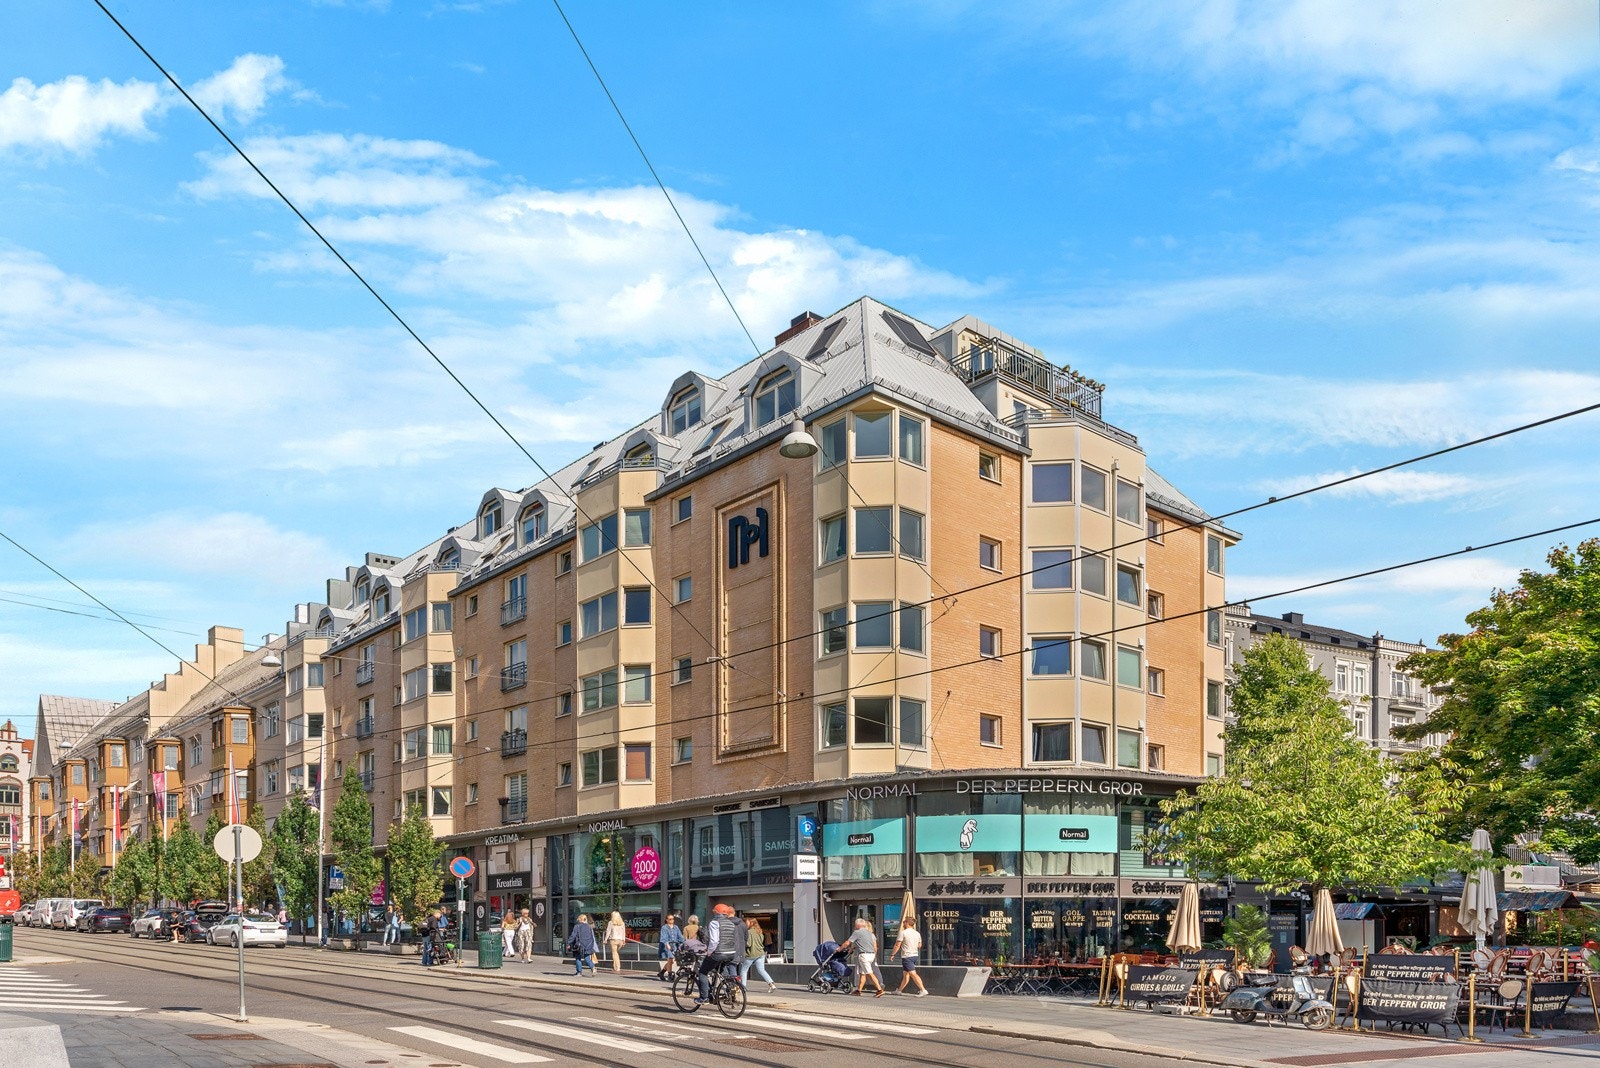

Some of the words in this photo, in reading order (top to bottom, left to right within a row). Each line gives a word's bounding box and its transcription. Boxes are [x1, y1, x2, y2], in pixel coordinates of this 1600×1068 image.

[846, 783, 922, 800] NORMAL
[956, 780, 996, 794] DER
[1005, 779, 1097, 793] PEPPERN
[1100, 781, 1143, 795] GROR
[588, 819, 626, 832] NORMAL
[485, 833, 519, 845] KREATIMA
[849, 834, 872, 844] Normal
[1062, 829, 1087, 838] Normal
[702, 845, 737, 856] SAMSØE
[764, 839, 796, 851] SAMSØ
[634, 859, 657, 873] 2000
[496, 877, 523, 888] Kreatima
[923, 910, 960, 918] CURRIES
[1124, 913, 1160, 921] COCKTAILS
[987, 923, 1007, 931] GROR
[1142, 974, 1177, 982] FAMOUS
[1370, 969, 1385, 977] DER
[1130, 983, 1154, 992] CURRIES
[1161, 983, 1186, 992] GRILLS
[1362, 998, 1377, 1006] DER
[1379, 999, 1418, 1008] PEPPERN
[1420, 1001, 1447, 1010] GROR
